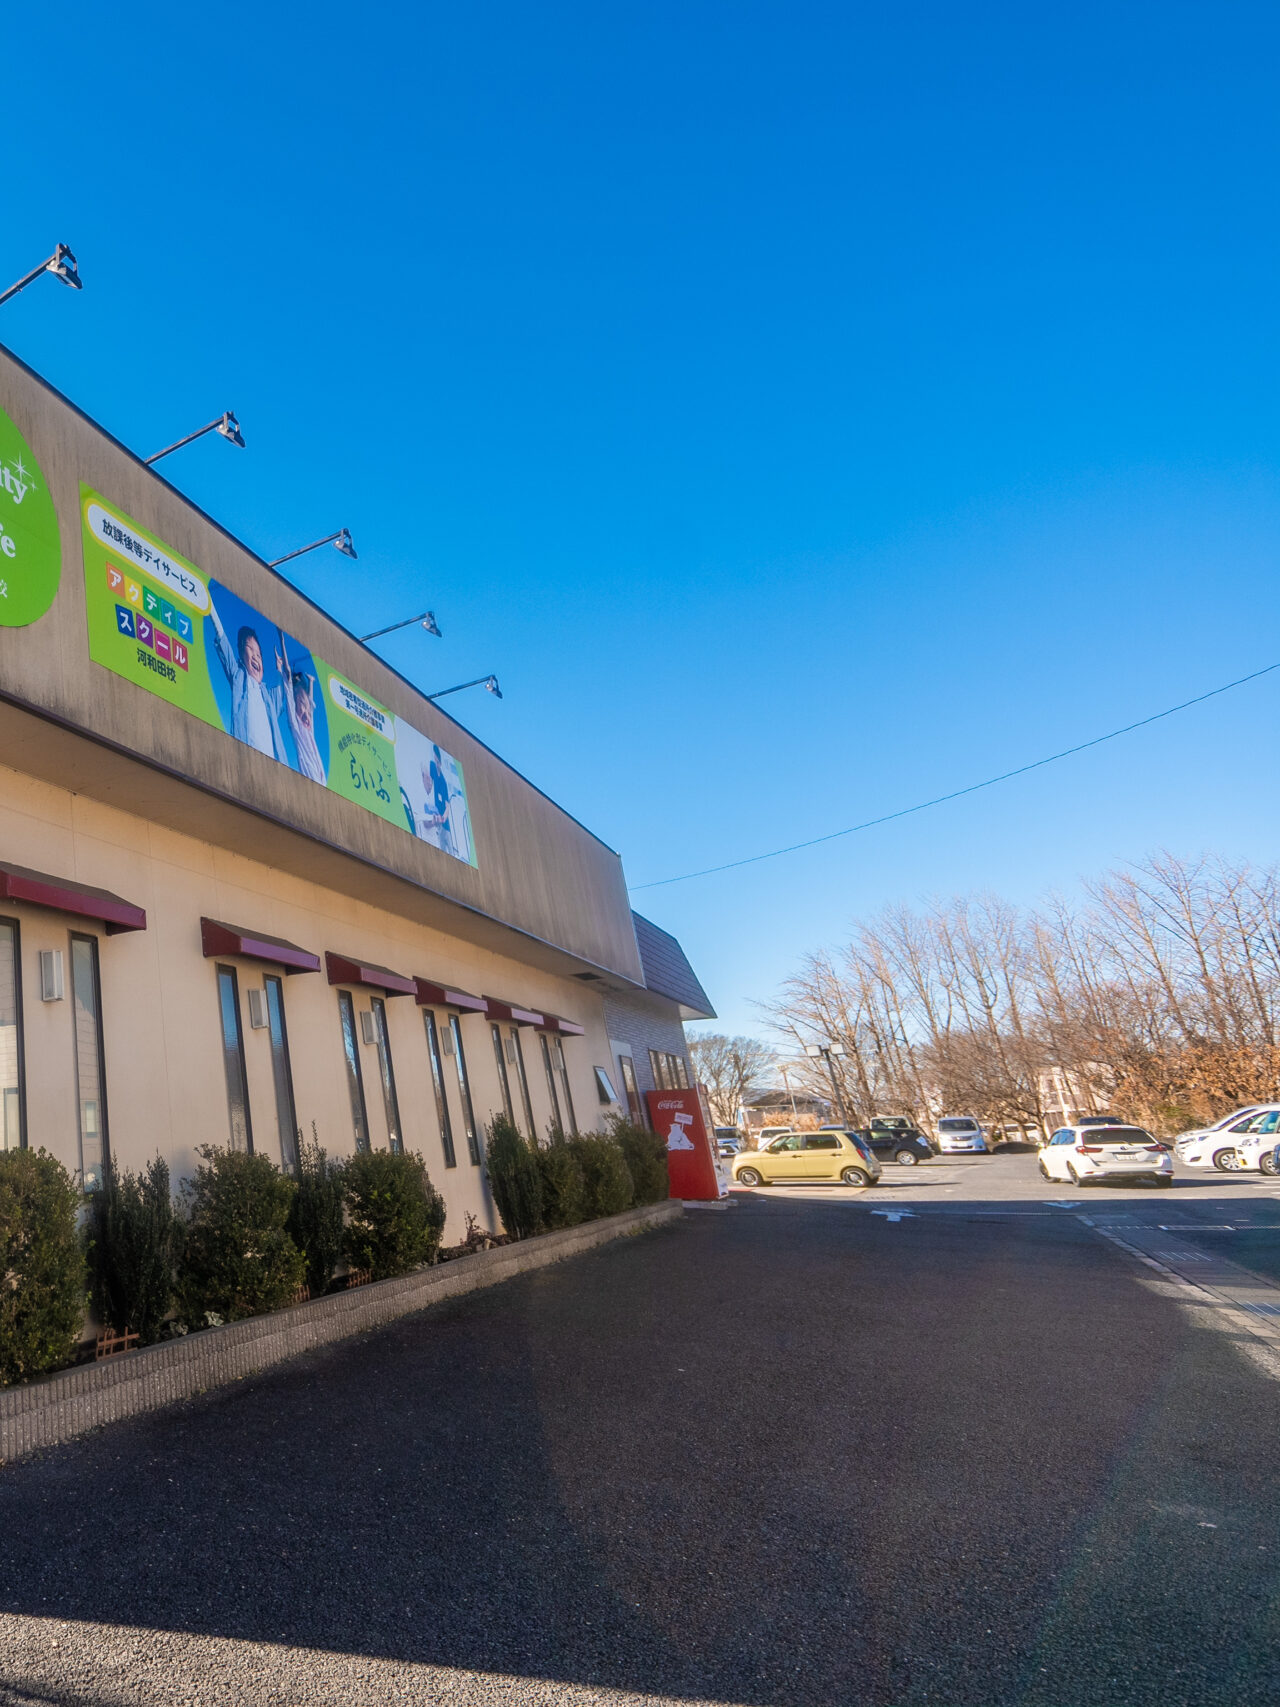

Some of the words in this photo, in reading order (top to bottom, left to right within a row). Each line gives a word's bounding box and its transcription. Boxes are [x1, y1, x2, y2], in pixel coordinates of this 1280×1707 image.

[102, 518, 198, 597] 放課後等デイサービス
[120, 611, 186, 664] スクール
[137, 647, 177, 684] 河和田校
[349, 751, 391, 803] らいふ
